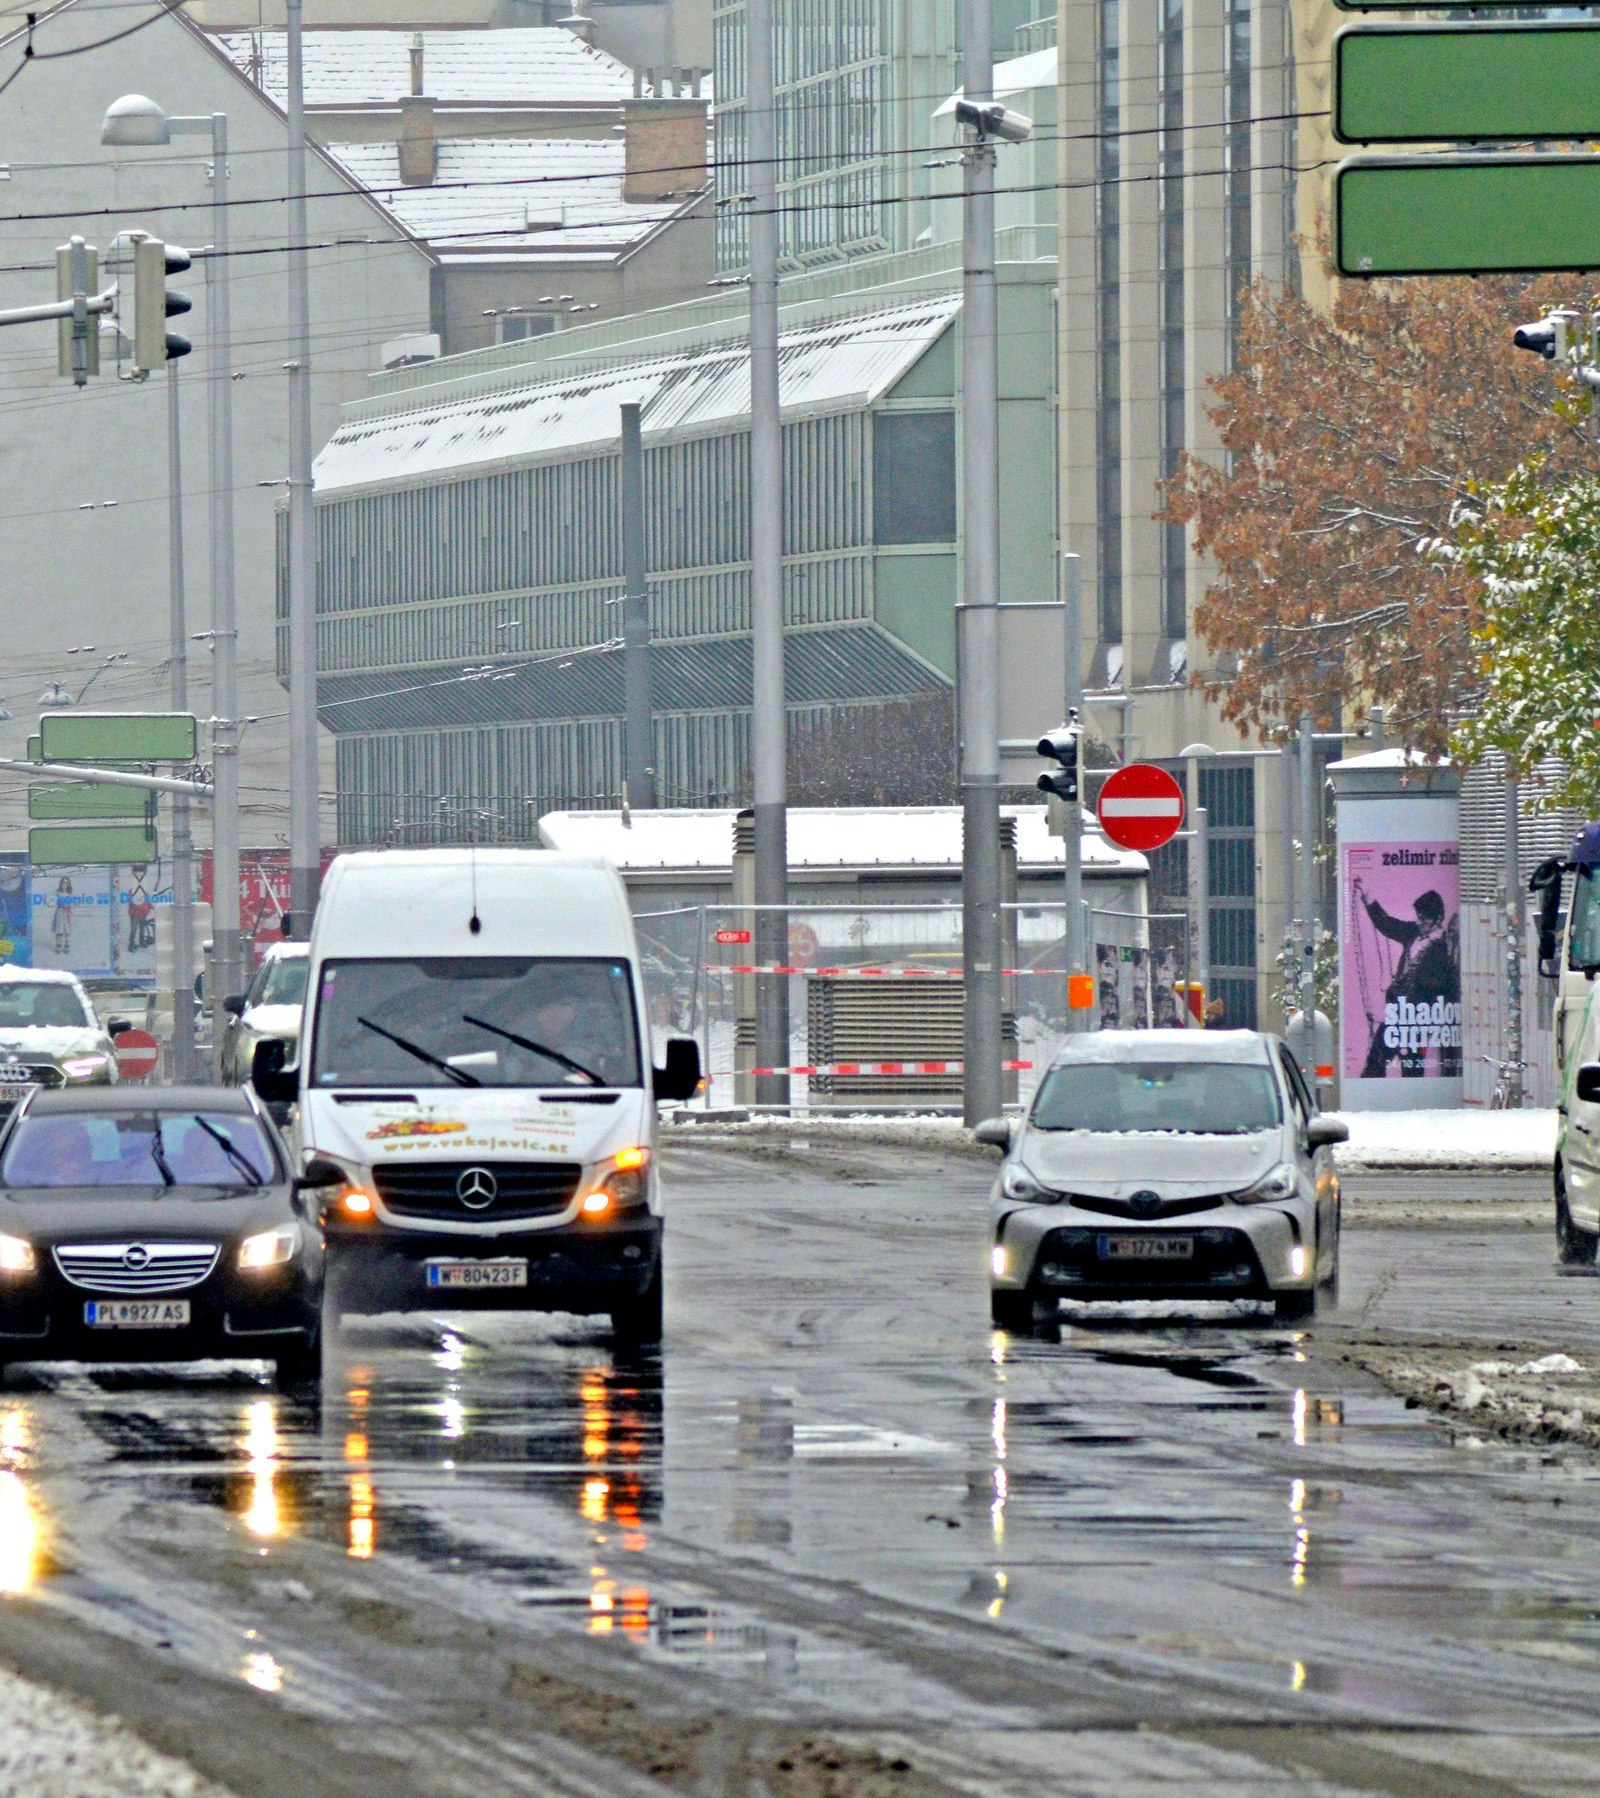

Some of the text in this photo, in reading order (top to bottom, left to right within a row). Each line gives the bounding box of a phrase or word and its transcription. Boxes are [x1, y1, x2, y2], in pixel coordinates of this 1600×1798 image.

[1382, 849, 1437, 866] zelimir
[32, 893, 95, 905] Dikonie
[1383, 1025, 1462, 1054] citizen
[1109, 1242, 1119, 1254] W
[441, 1269, 452, 1282] W
[100, 1304, 184, 1320] PL 927 AS
